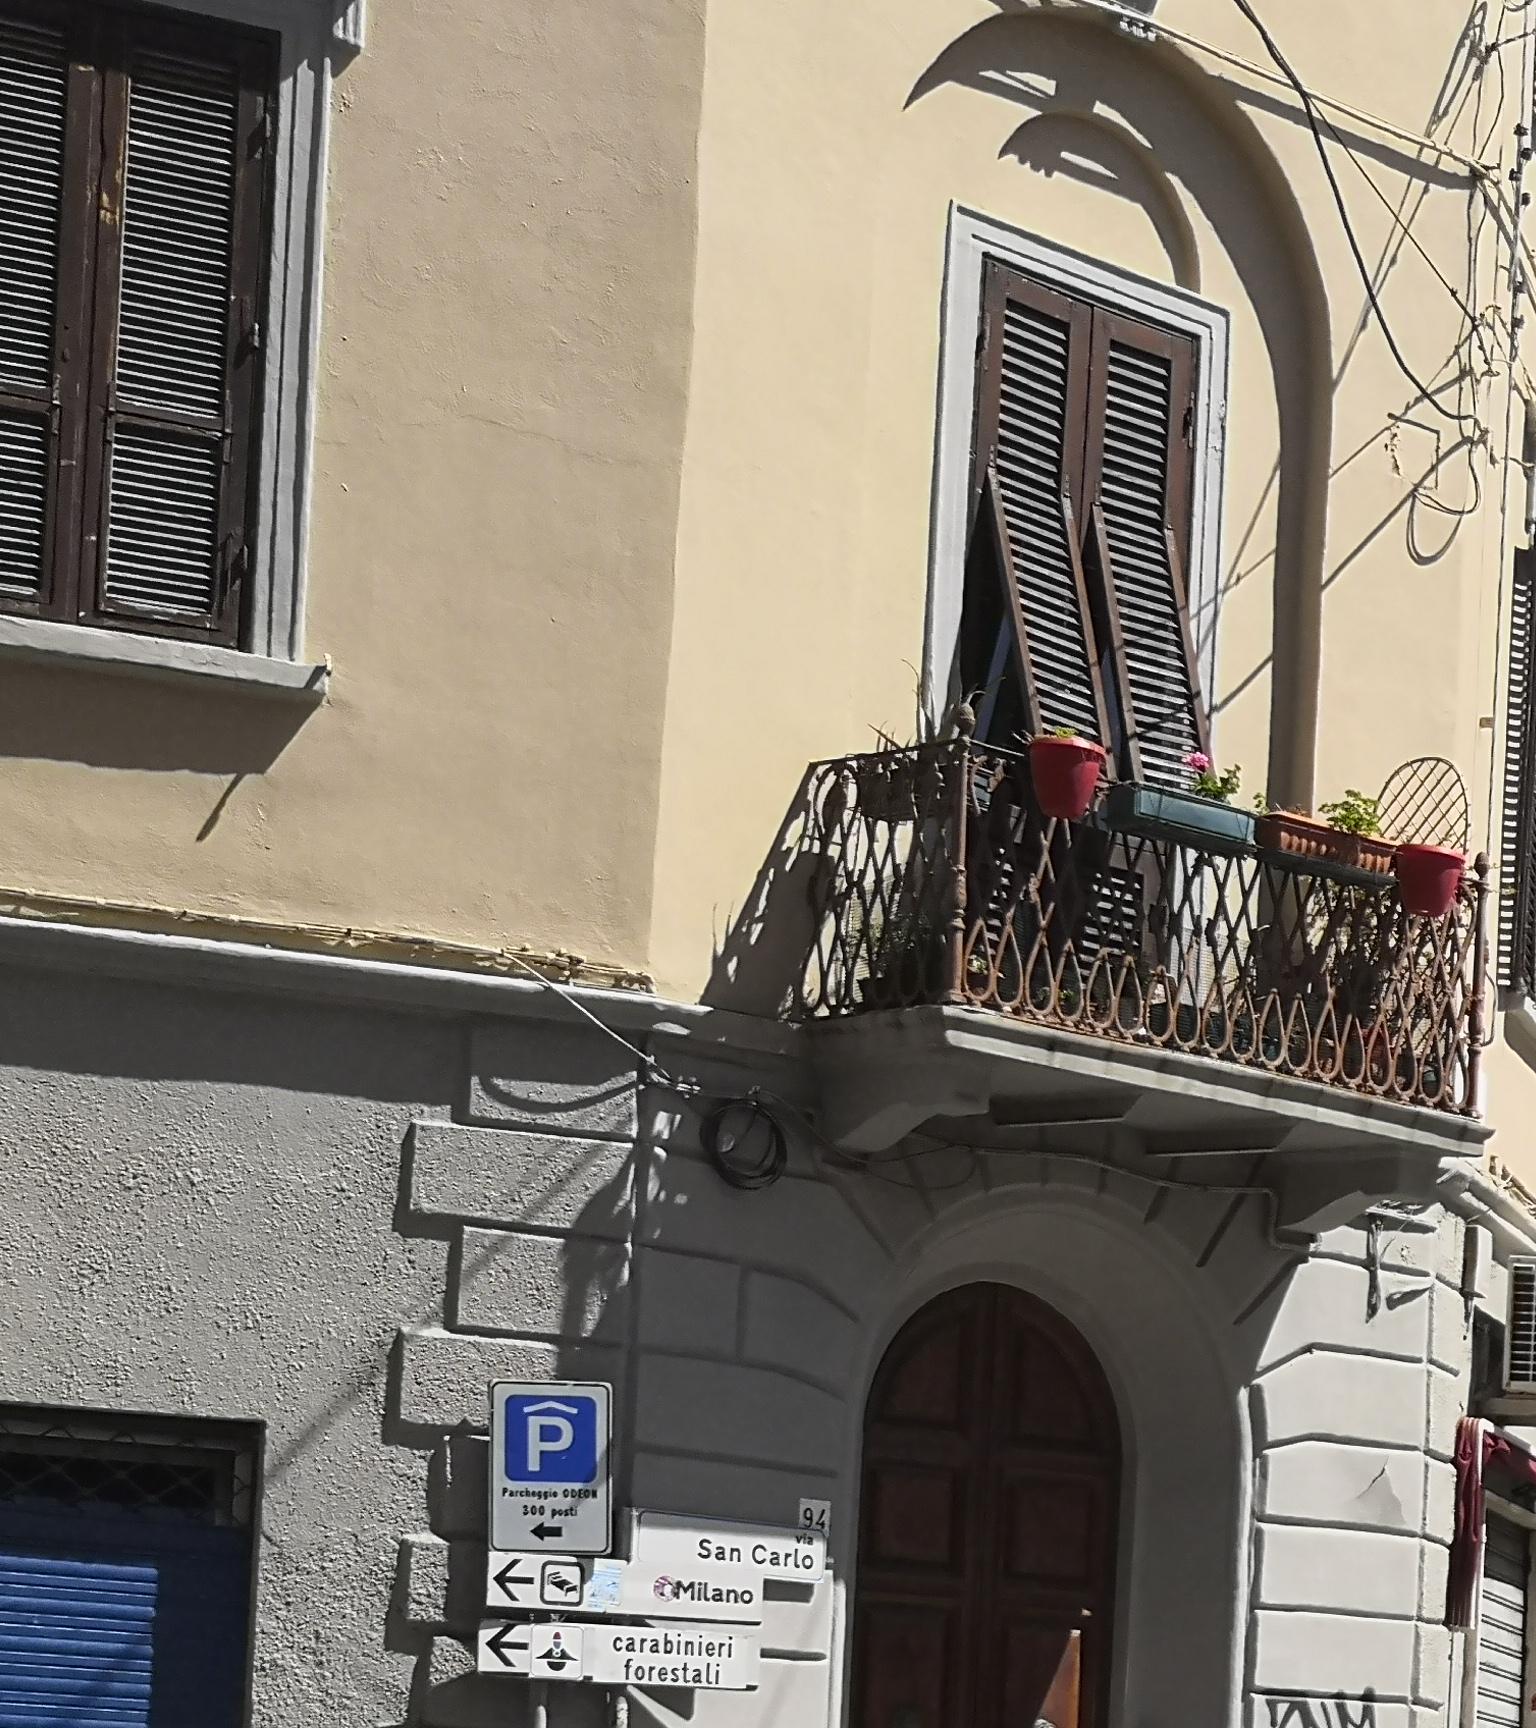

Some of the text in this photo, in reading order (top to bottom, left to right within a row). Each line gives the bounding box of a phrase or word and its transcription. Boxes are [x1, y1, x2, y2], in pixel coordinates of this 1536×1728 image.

[527, 1415, 575, 1472] P
[501, 1487, 598, 1500] Parcheggio ODEON
[522, 1504, 578, 1519] 300 posti
[803, 1507, 826, 1530] 94
[796, 1533, 814, 1545] via
[697, 1538, 814, 1570] San Carlo
[675, 1580, 754, 1605] Milano
[612, 1632, 733, 1659] carabinieri
[624, 1659, 721, 1685] forestali
